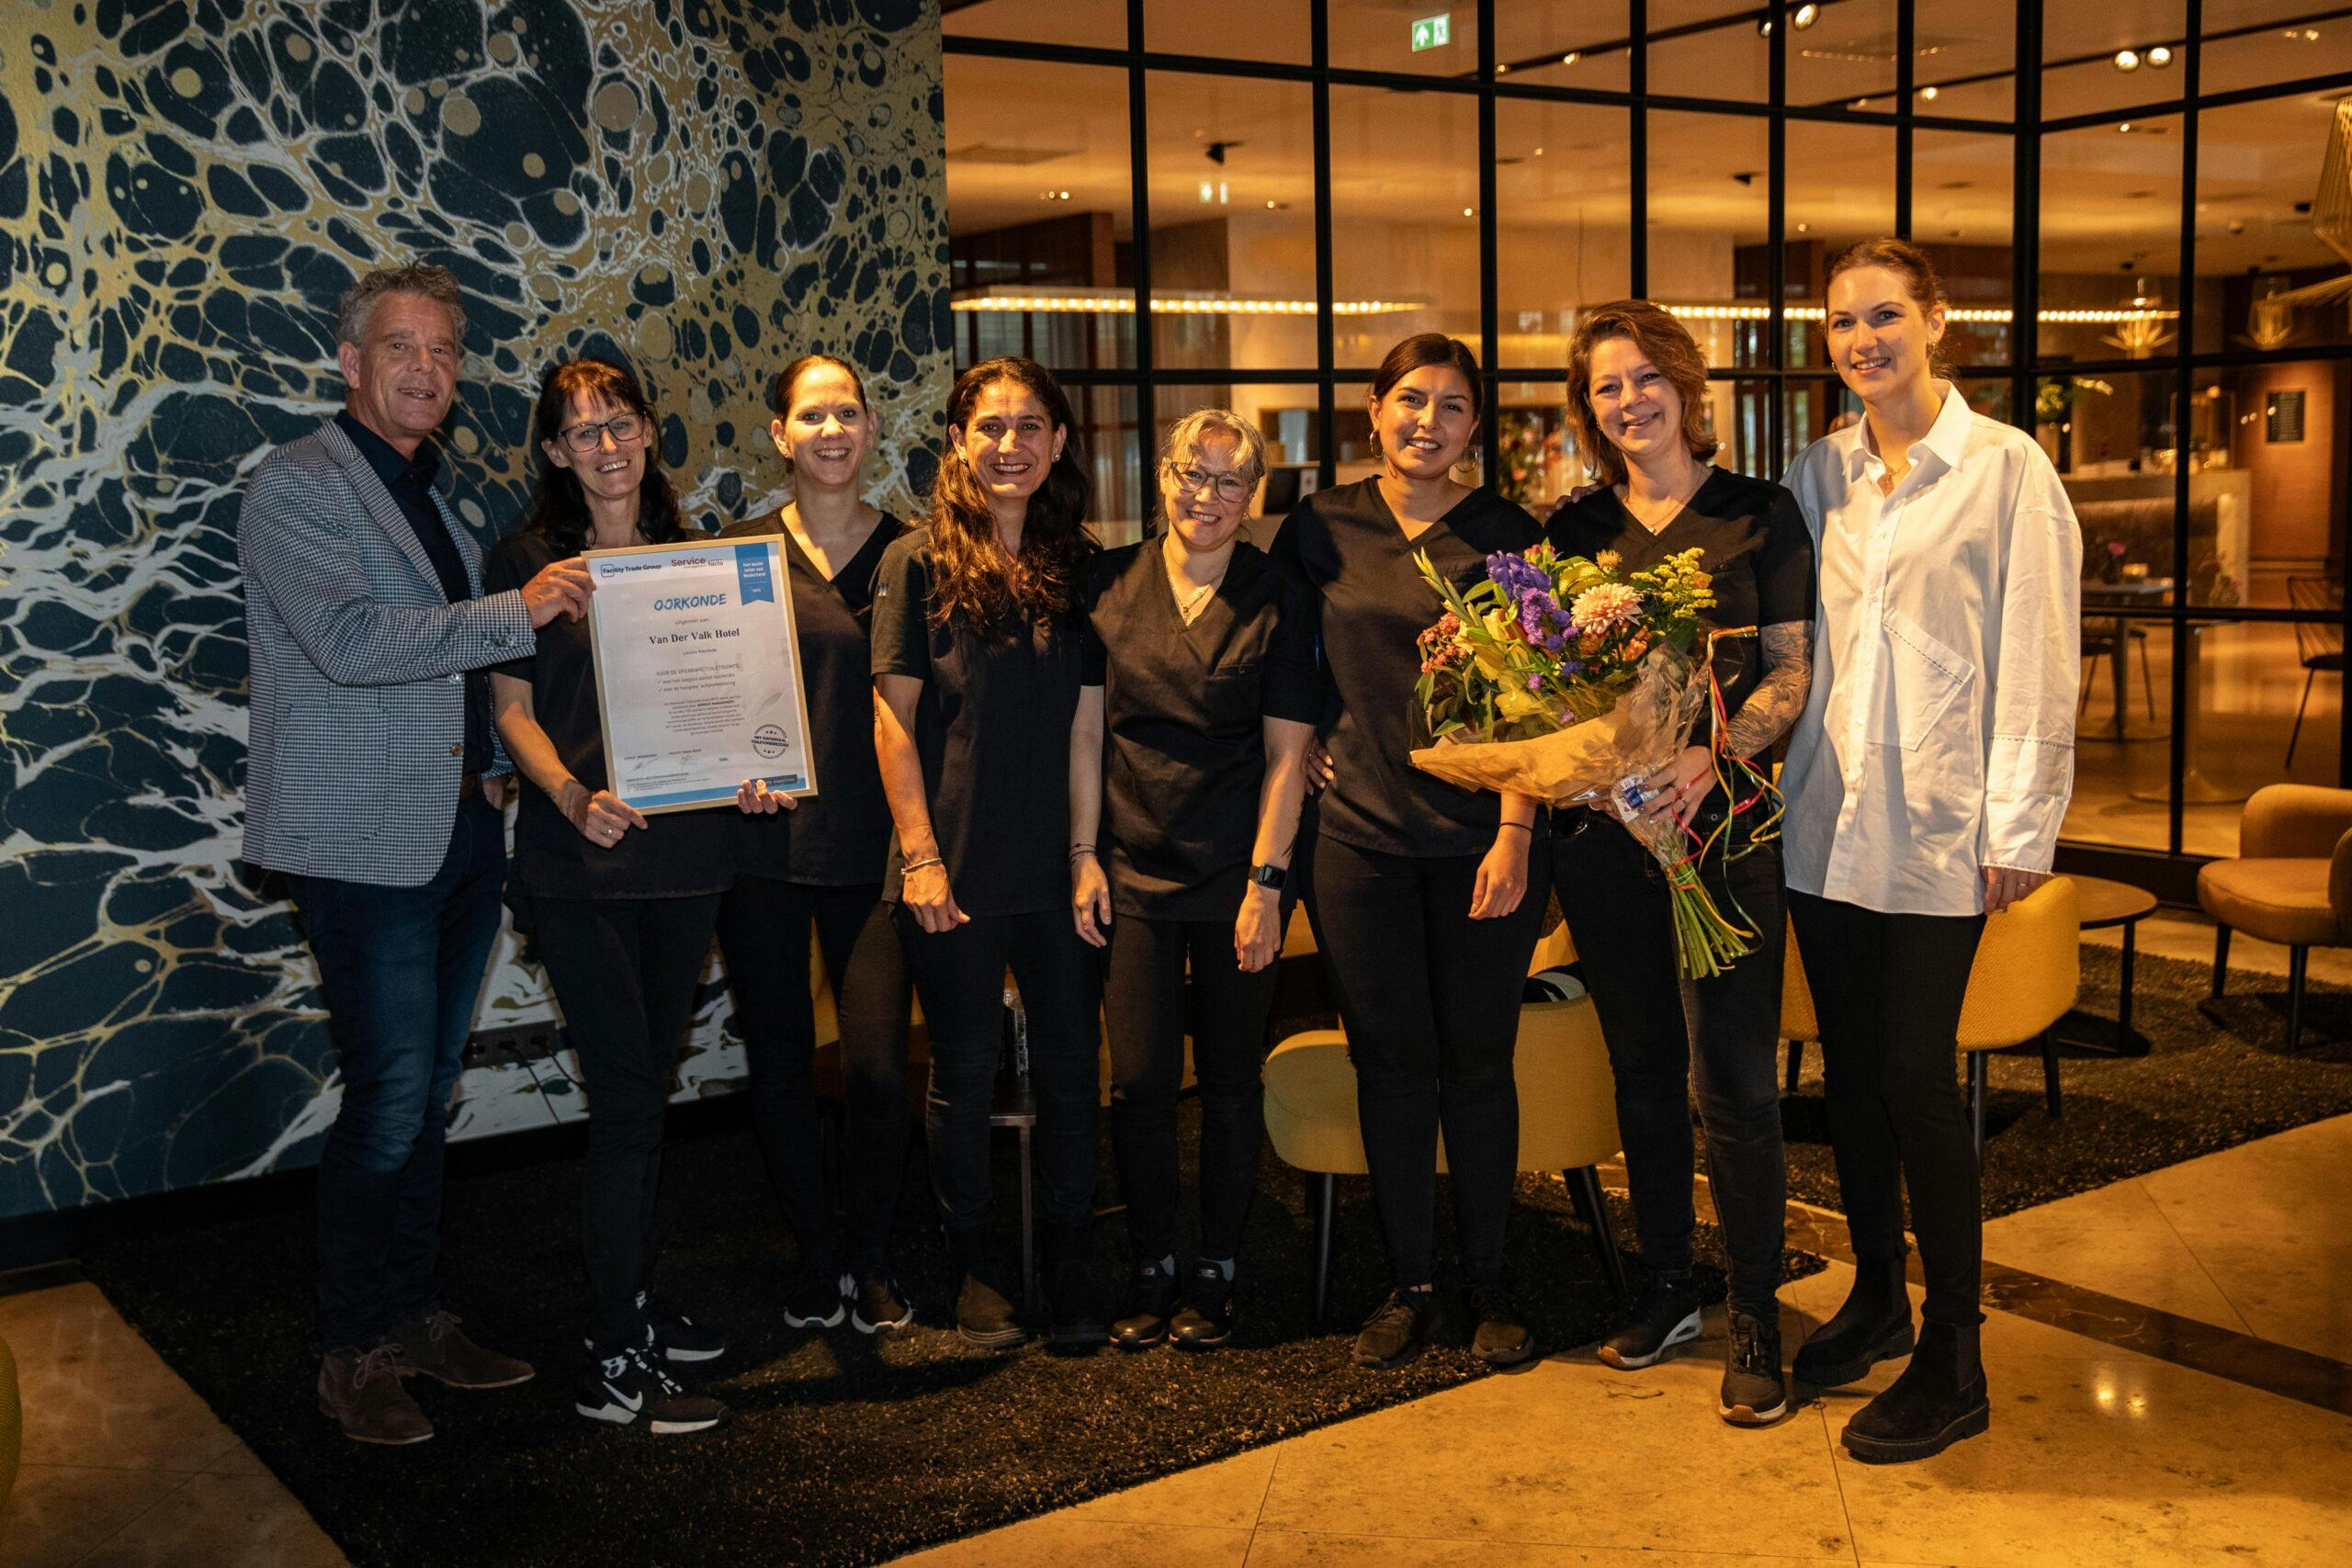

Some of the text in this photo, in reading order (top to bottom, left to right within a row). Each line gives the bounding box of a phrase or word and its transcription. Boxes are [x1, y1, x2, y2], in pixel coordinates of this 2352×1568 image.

[643, 563, 662, 571] Group
[671, 557, 706, 567] Service
[654, 593, 727, 611] OORKONDE
[649, 627, 740, 645] Van Der Valk Hotel
